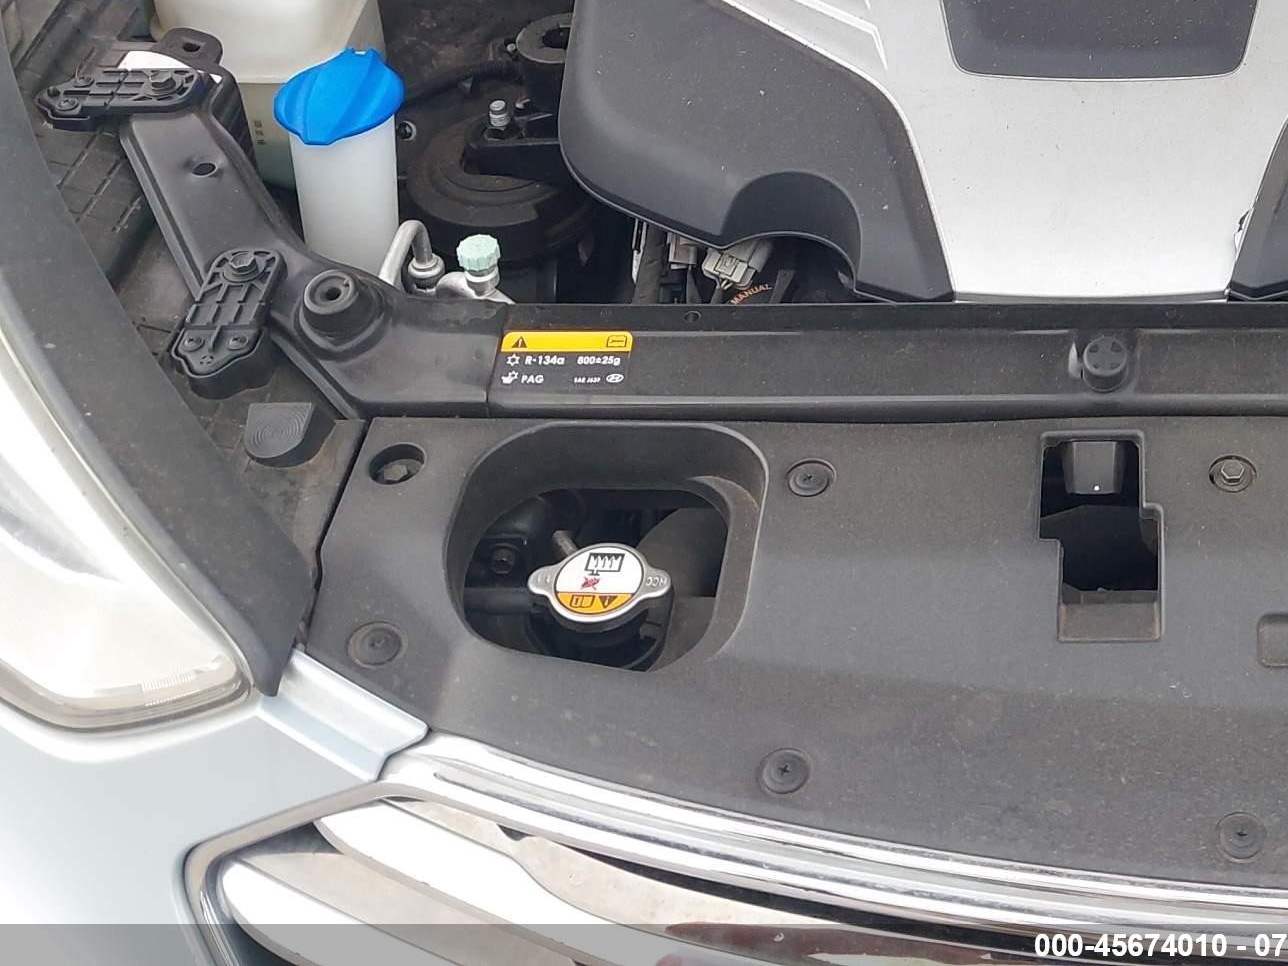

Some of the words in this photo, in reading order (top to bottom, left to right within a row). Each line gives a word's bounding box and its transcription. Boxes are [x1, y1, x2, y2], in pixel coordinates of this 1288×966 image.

[730, 283, 773, 305] MANUAL
[524, 355, 566, 366] R-134a
[520, 374, 544, 384] PAG
